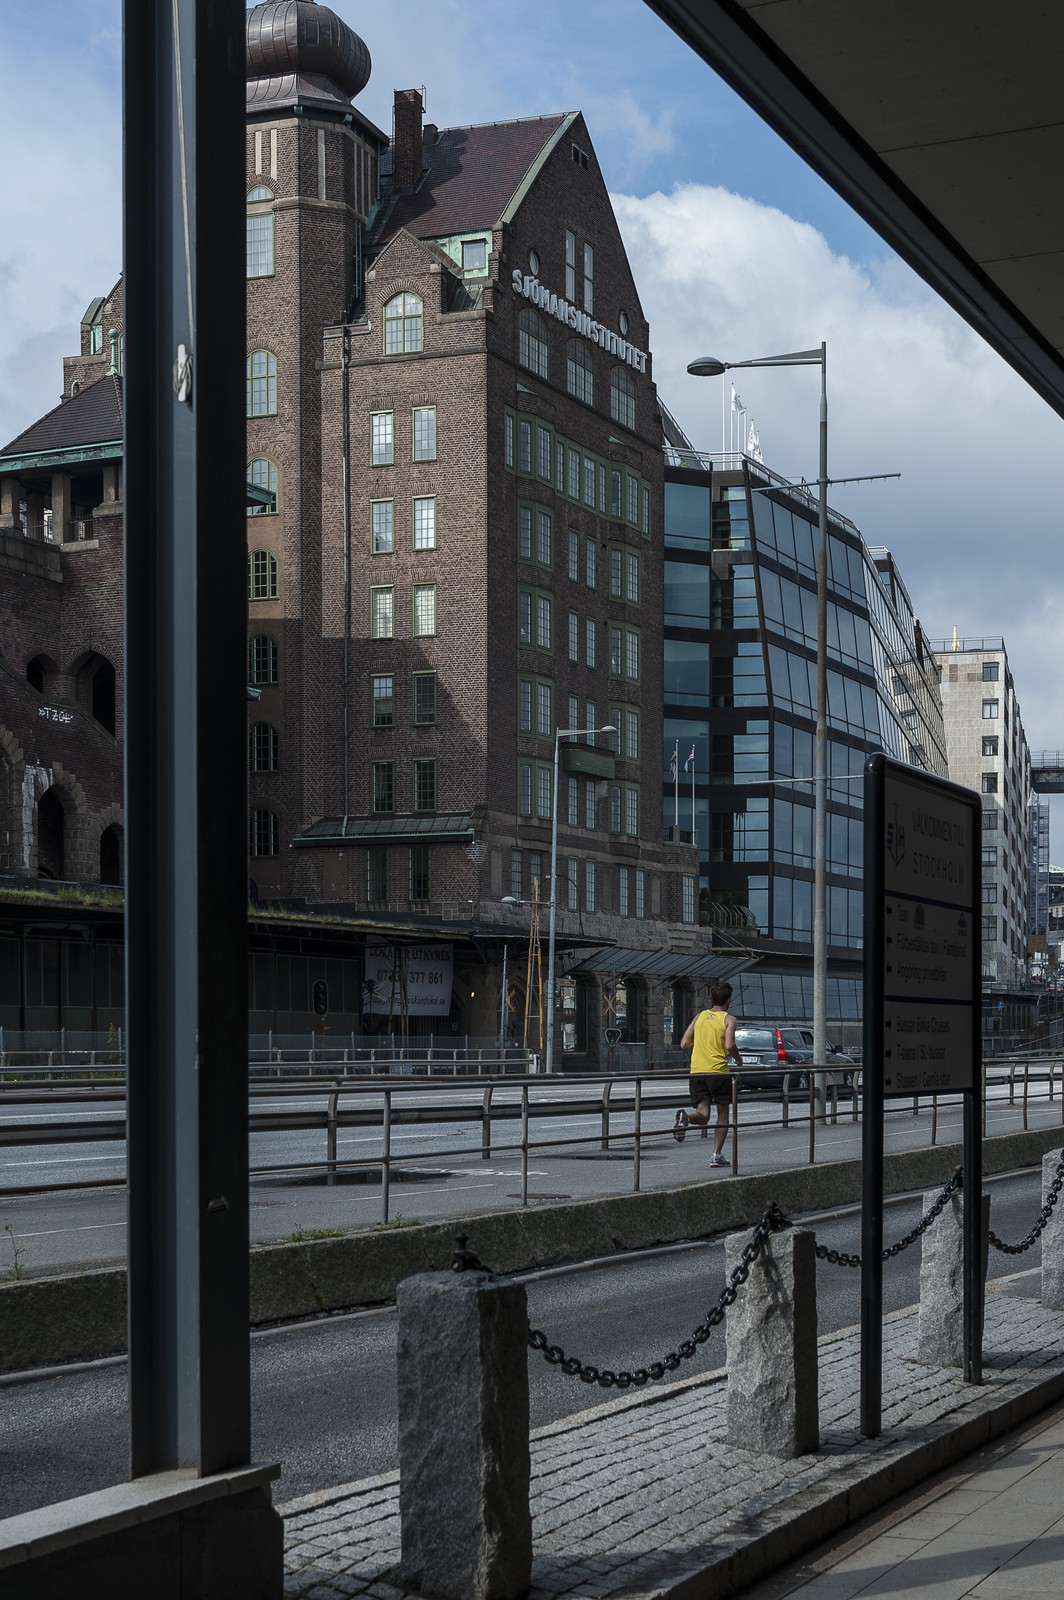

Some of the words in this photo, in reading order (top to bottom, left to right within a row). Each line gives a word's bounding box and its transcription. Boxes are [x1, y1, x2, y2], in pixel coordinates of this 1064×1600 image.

[912, 808, 953, 843] VÄLKOMMEN
[953, 823, 967, 848] TILL
[912, 851, 965, 885] STOCKHOLM
[897, 904, 909, 922] Taxi
[370, 947, 410, 960] LOKAR
[412, 949, 451, 961] UTHYRES
[409, 971, 426, 984] 377
[428, 972, 443, 985] 861
[897, 1015, 916, 1033] Bussar
[897, 1043, 916, 1061] T-bana
